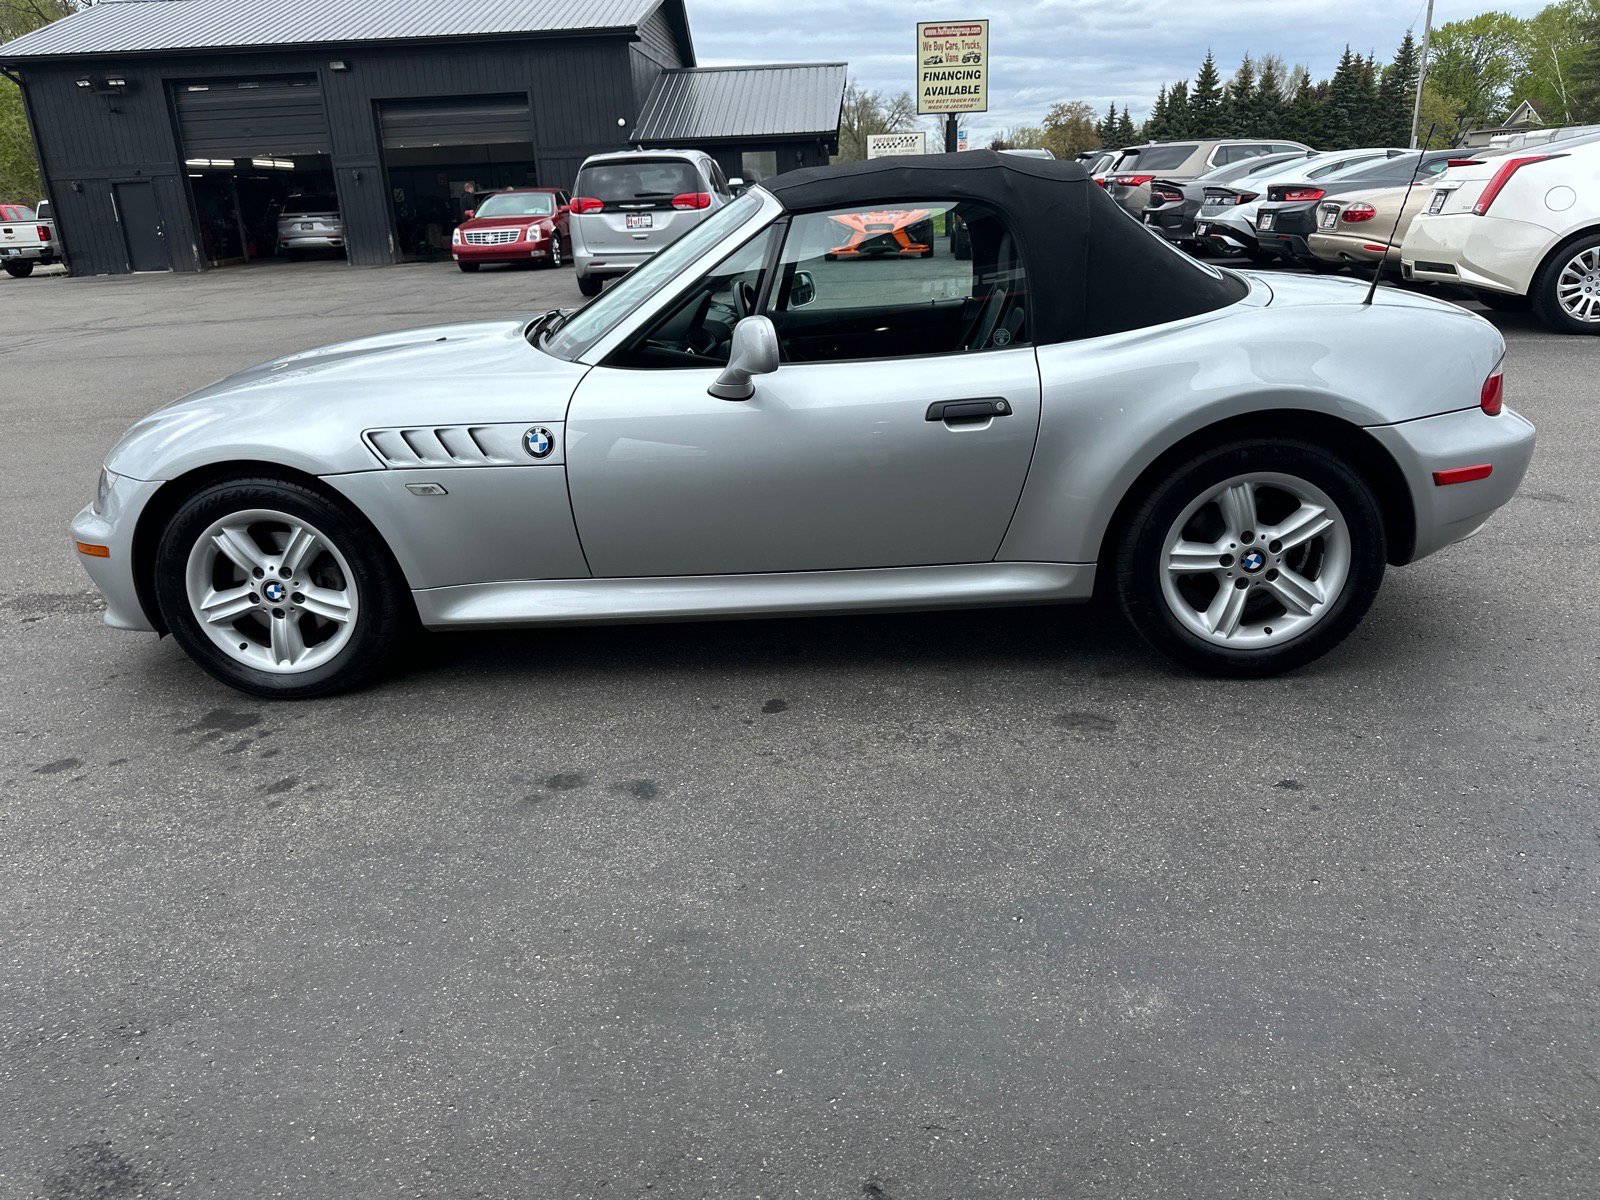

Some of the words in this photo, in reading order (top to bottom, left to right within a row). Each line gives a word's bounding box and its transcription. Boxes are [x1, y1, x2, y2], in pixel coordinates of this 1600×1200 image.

[923, 41, 932, 51] We
[933, 40, 944, 53] Buy
[945, 40, 960, 52] Cars,
[961, 39, 982, 51] Trucks,
[945, 52, 959, 63] Vans
[923, 70, 982, 82] FINANCING
[924, 85, 981, 96] AVAILABLE
[627, 217, 643, 225] Huff
